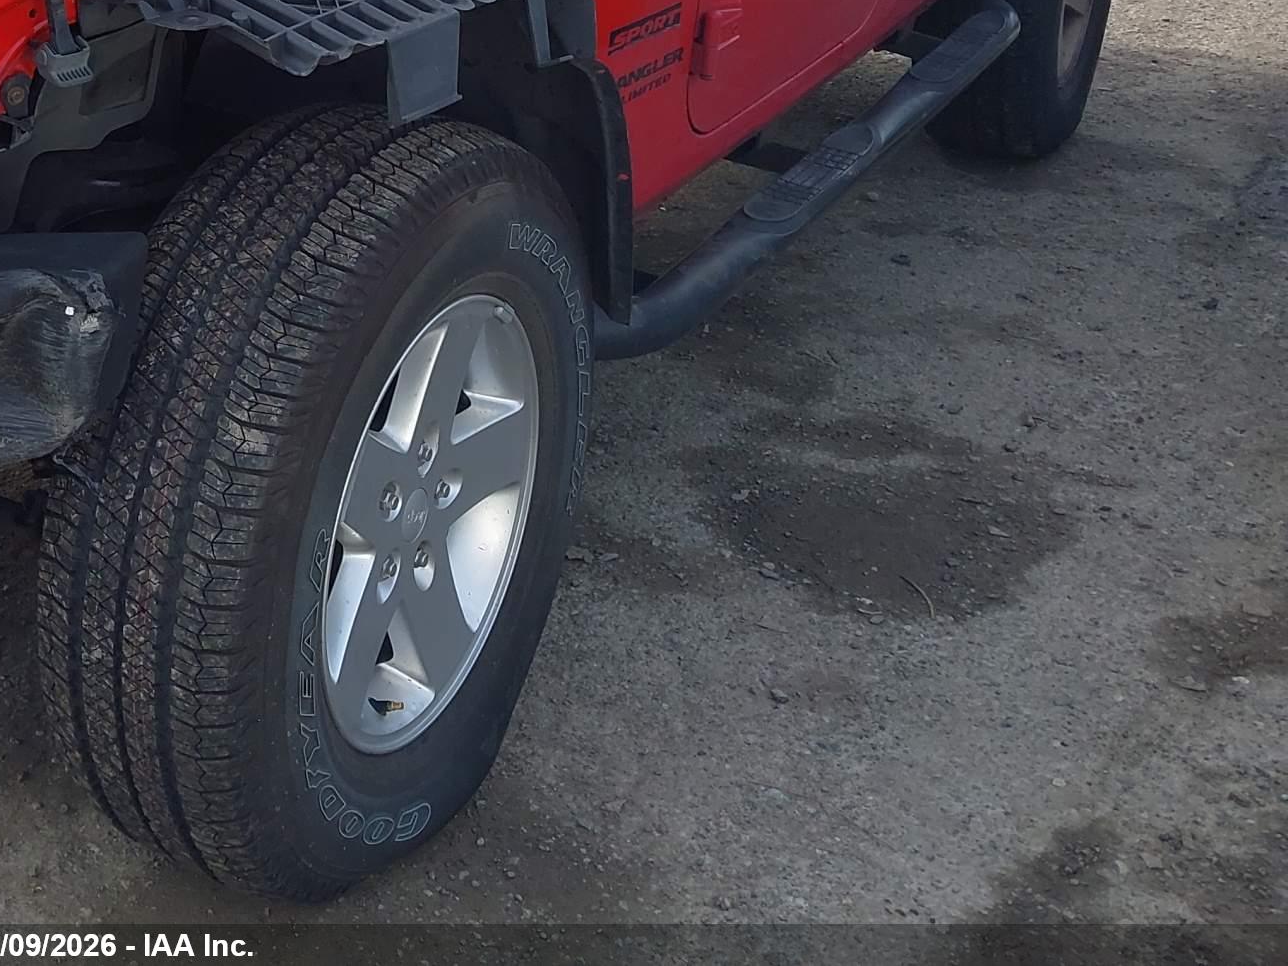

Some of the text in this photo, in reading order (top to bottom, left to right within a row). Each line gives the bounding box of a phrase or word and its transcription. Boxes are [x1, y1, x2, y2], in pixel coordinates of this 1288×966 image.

[610, 8, 680, 54] SPORT
[617, 47, 684, 88] ANGLER
[509, 222, 591, 516] WRANGLER
[299, 528, 431, 845] GOODYEAR
